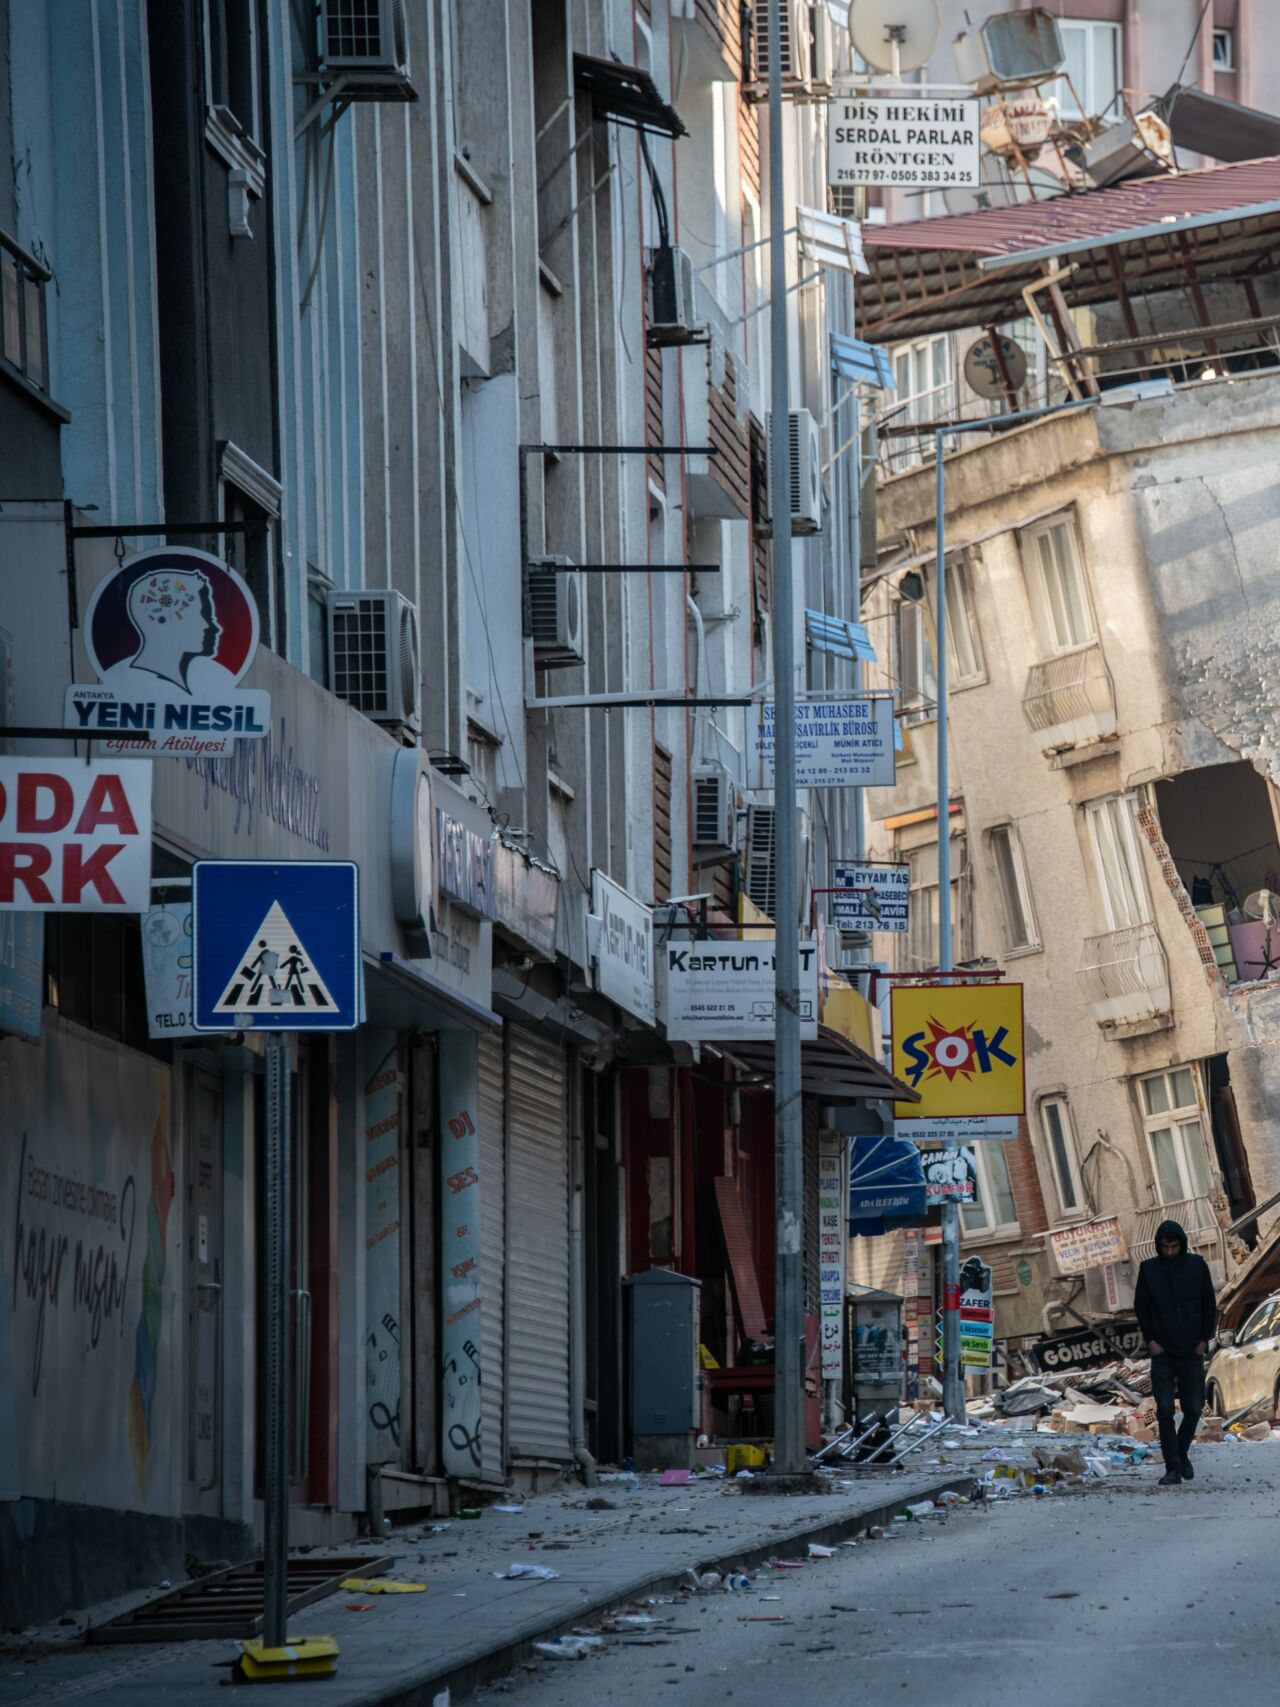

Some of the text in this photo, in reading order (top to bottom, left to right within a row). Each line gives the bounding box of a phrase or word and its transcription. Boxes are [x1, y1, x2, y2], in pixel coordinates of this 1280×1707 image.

[843, 101, 879, 125] DİŞ
[886, 103, 965, 121] HEKİMİ
[835, 128, 974, 145] SERDAL PARLAR
[855, 148, 955, 166] RÖNTGEN
[837, 169, 856, 180] 216
[858, 169, 870, 180] 77
[921, 170, 940, 181] 383
[943, 170, 956, 182] 34
[959, 171, 972, 182] 25
[73, 690, 115, 700] ANTAKYA
[764, 704, 869, 721] SEEST MUHASEBE
[843, 720, 879, 735] BÜROSU
[161, 735, 229, 754] Atölyesi
[834, 738, 861, 748] MÜNİR
[0, 772, 140, 835] DA
[855, 873, 887, 884] EYYAM
[855, 921, 874, 929] 213
[894, 921, 906, 930] 15
[902, 1025, 1017, 1088] ŞOK
[921, 1150, 959, 1167] CANAN
[960, 1298, 990, 1308] ZAFER
[1043, 1339, 1107, 1366] GÖKSEL
